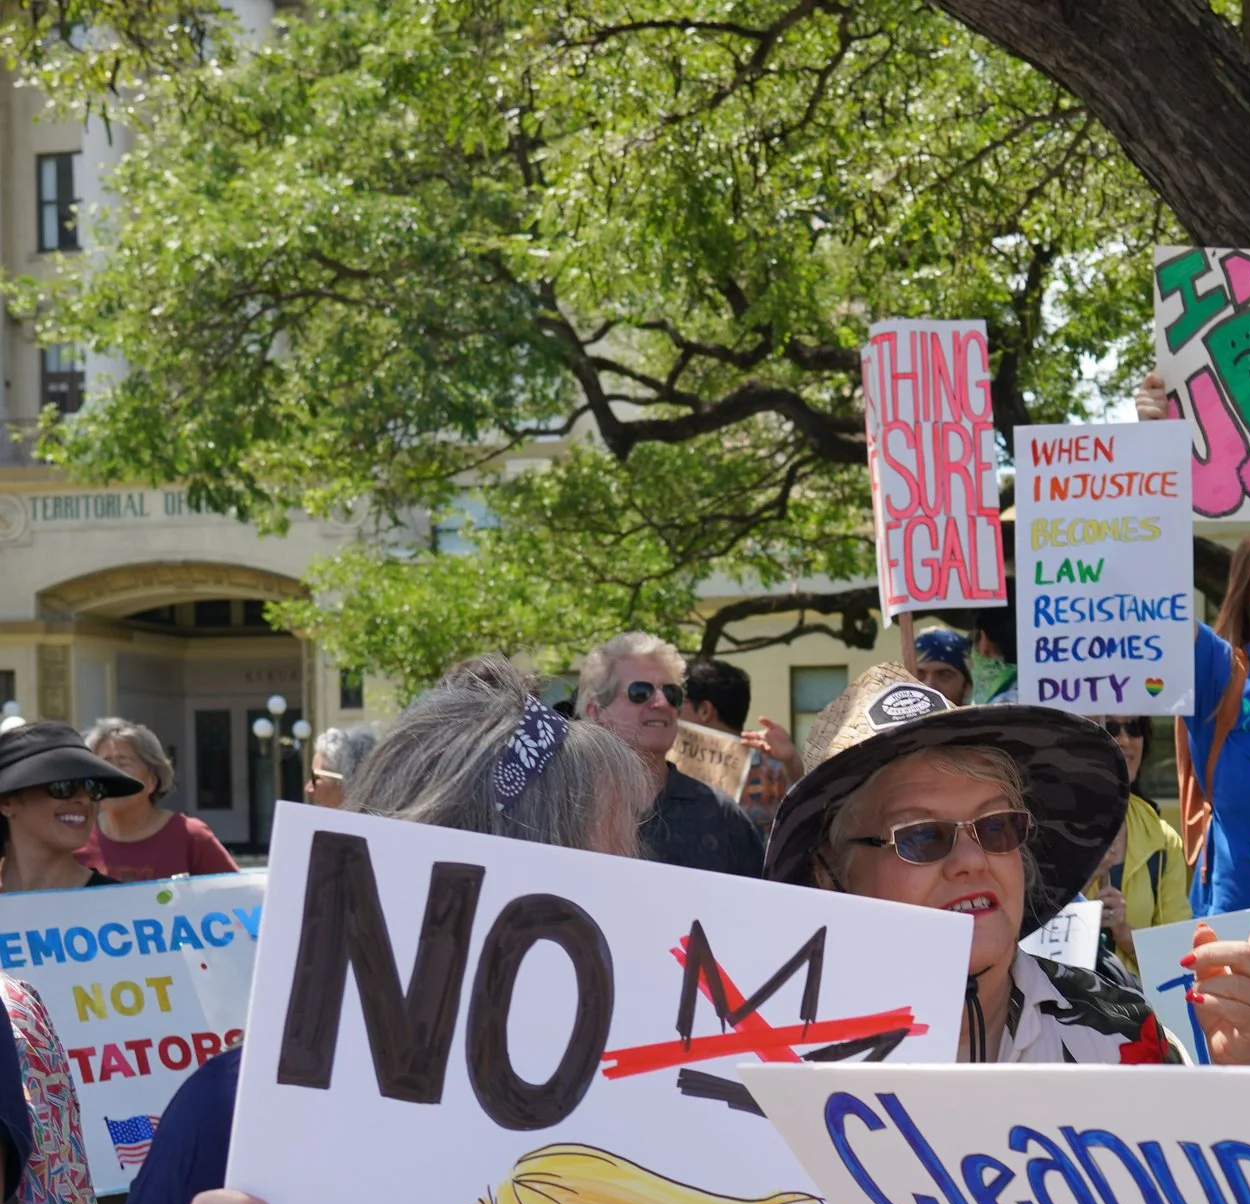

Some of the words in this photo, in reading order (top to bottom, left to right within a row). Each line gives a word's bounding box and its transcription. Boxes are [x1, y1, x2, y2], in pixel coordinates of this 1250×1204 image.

[1031, 435, 1114, 468] WHEN
[1033, 471, 1178, 502] INJUSTICE
[29, 492, 150, 521] TERRITORIAL
[1031, 515, 1163, 551] BECOMES
[1034, 558, 1105, 585] LAW
[1033, 593, 1190, 628] RESISTANCE
[1034, 635, 1163, 663] BECOMES
[1037, 674, 1131, 704] DUTY
[680, 741, 739, 769] JUSTICE
[0, 904, 264, 969] EMOCRACY
[277, 830, 616, 1131] NO
[72, 976, 174, 1022] NOT
